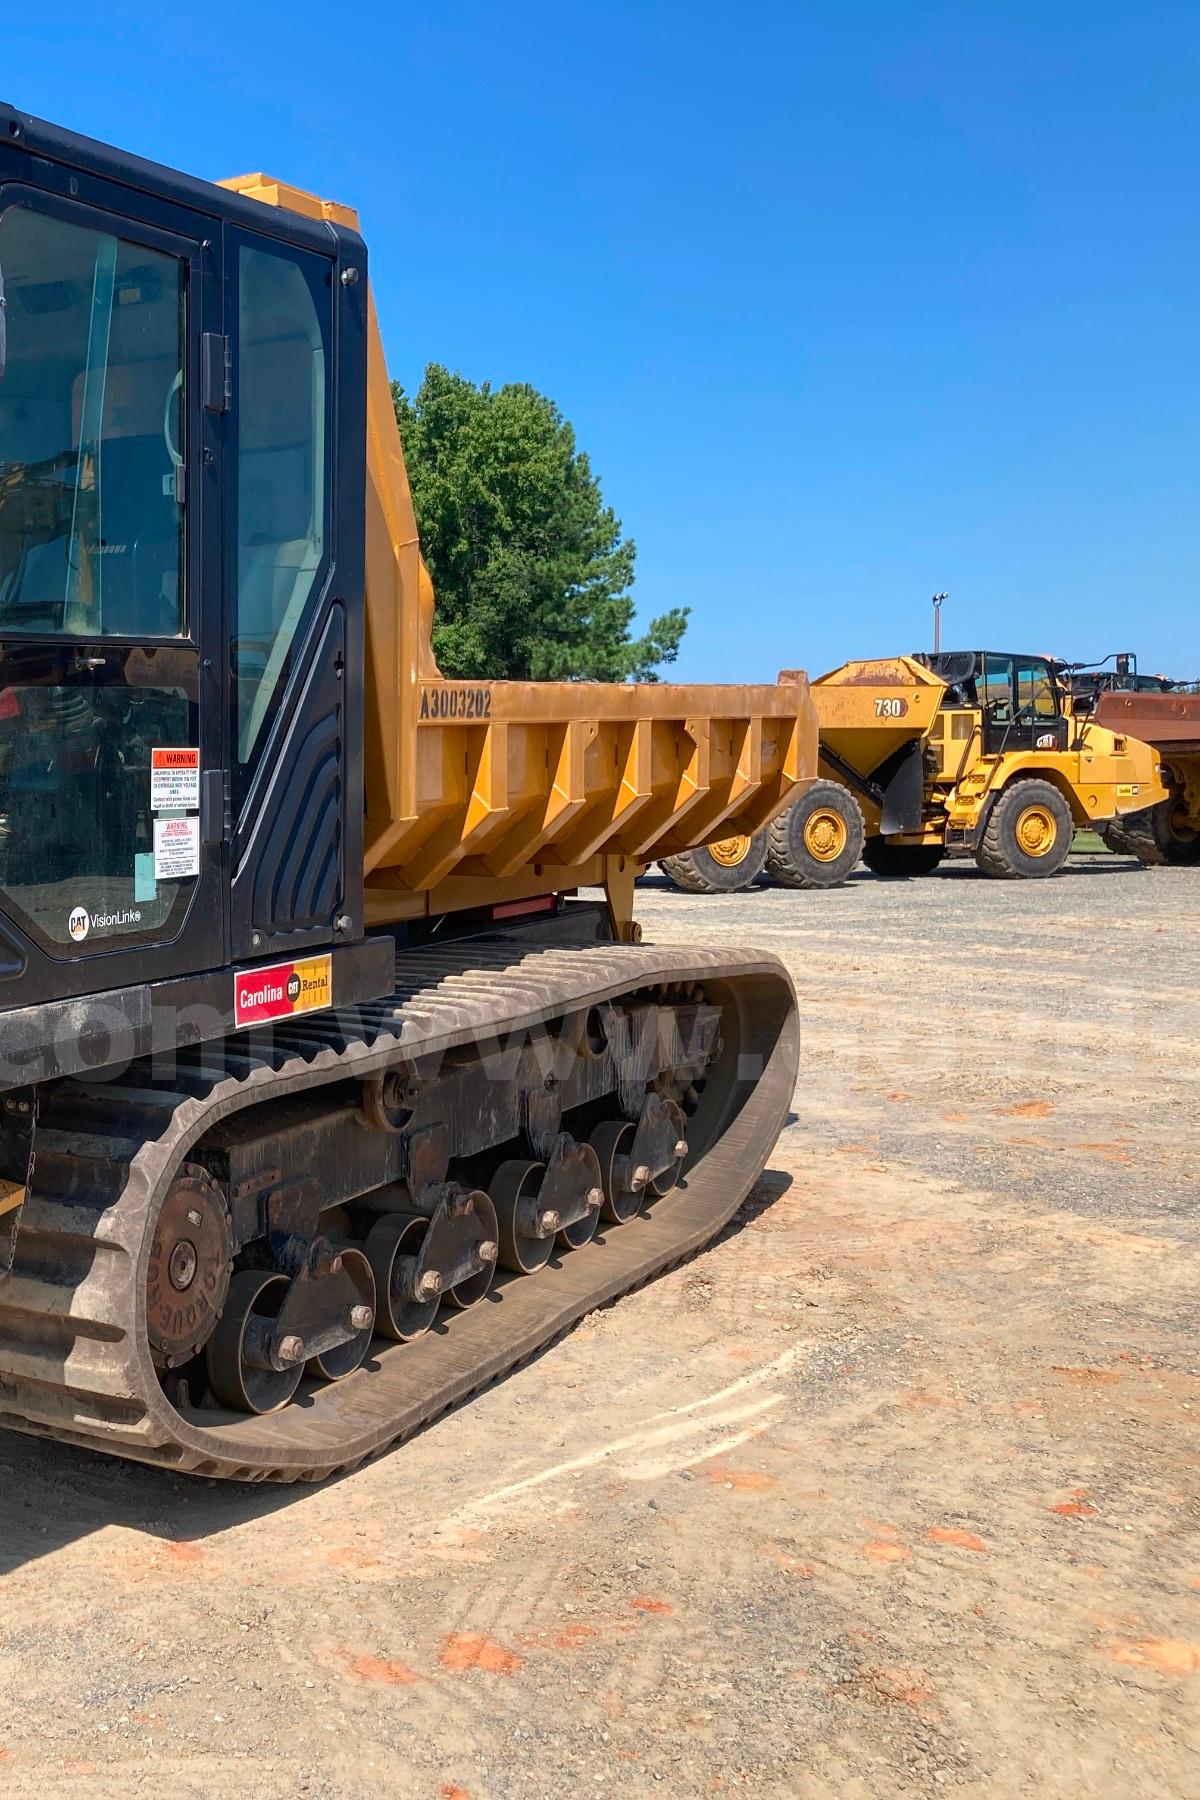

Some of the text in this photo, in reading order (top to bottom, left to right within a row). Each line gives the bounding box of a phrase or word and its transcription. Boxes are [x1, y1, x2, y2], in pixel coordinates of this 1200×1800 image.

[419, 688, 492, 719] A3003202
[874, 698, 901, 717] 730
[166, 753, 196, 764] WARNING
[70, 915, 87, 933] CAT
[240, 975, 329, 1009] Carolina CAT Rental
